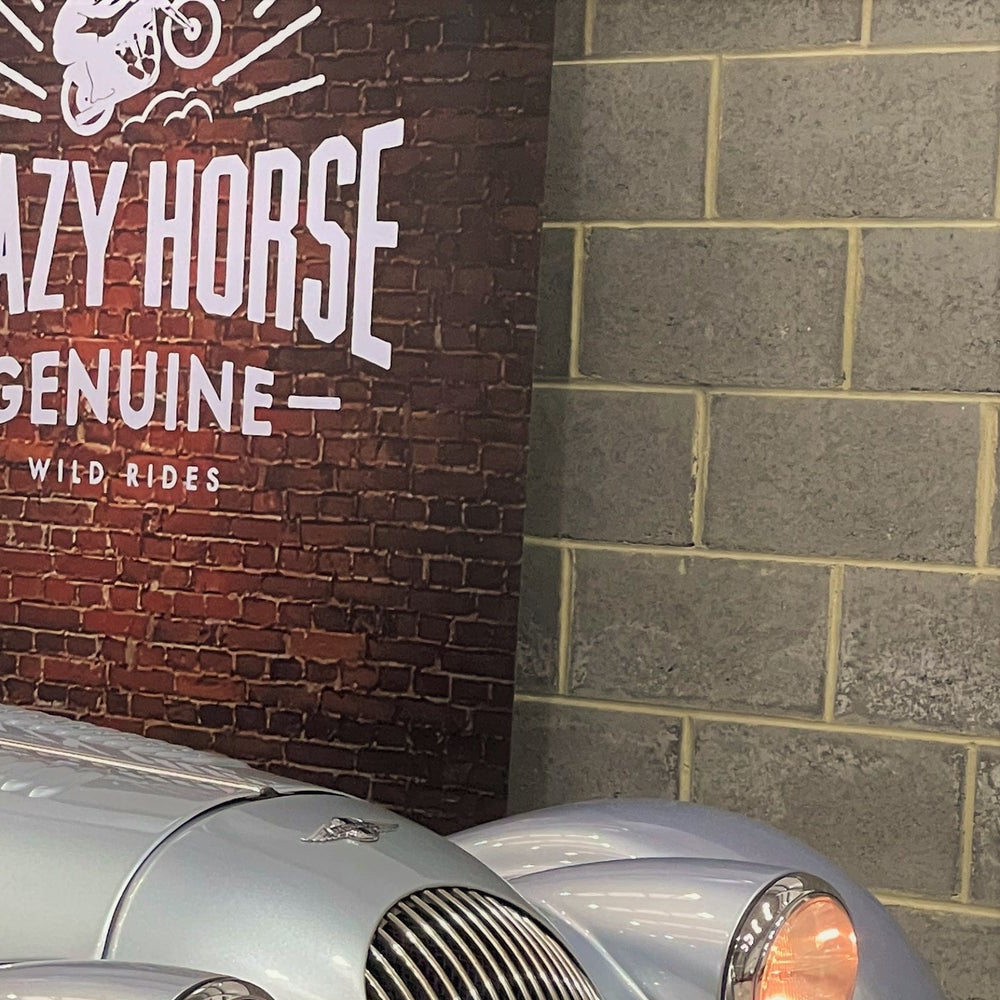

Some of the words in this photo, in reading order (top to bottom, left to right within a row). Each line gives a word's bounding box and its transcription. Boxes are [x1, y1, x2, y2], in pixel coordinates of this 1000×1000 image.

[143, 117, 405, 370] HORSE
[27, 456, 105, 485] WILD
[125, 462, 221, 492] RIDES
